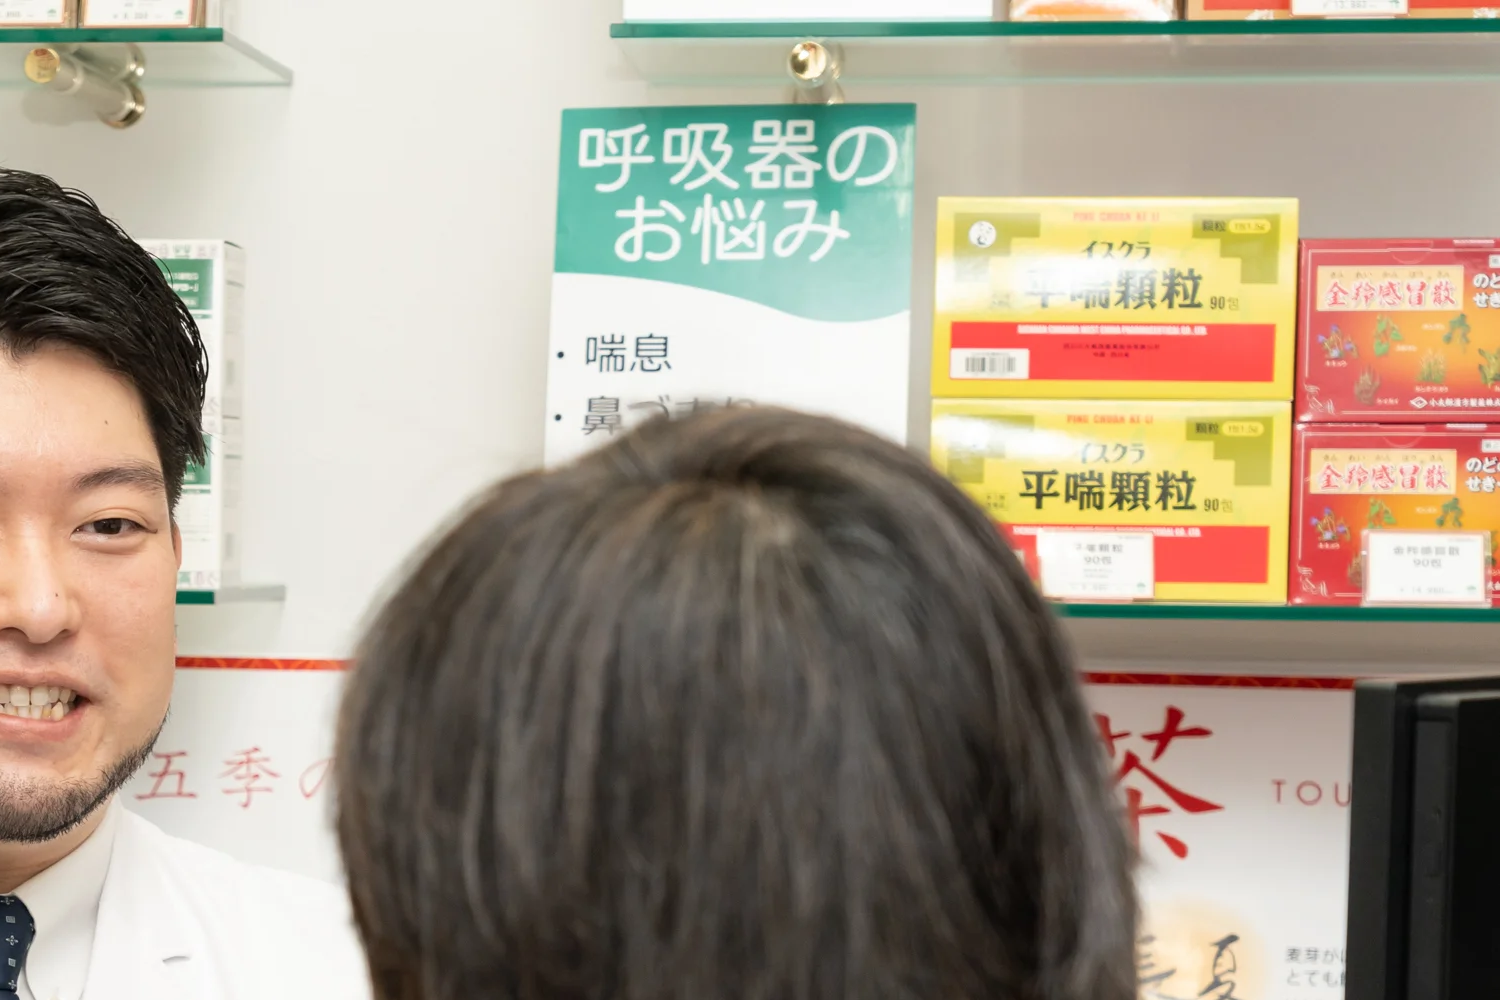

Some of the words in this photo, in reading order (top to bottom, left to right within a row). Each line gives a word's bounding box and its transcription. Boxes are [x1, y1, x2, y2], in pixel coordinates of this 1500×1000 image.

[578, 119, 899, 193] 呼吸器の
[614, 194, 850, 264] お悩み
[1083, 240, 1152, 260] イスクラ
[585, 333, 672, 373] 喘息
[1019, 469, 1198, 512] 平喘顆粒
[1093, 704, 1226, 862] 茶
